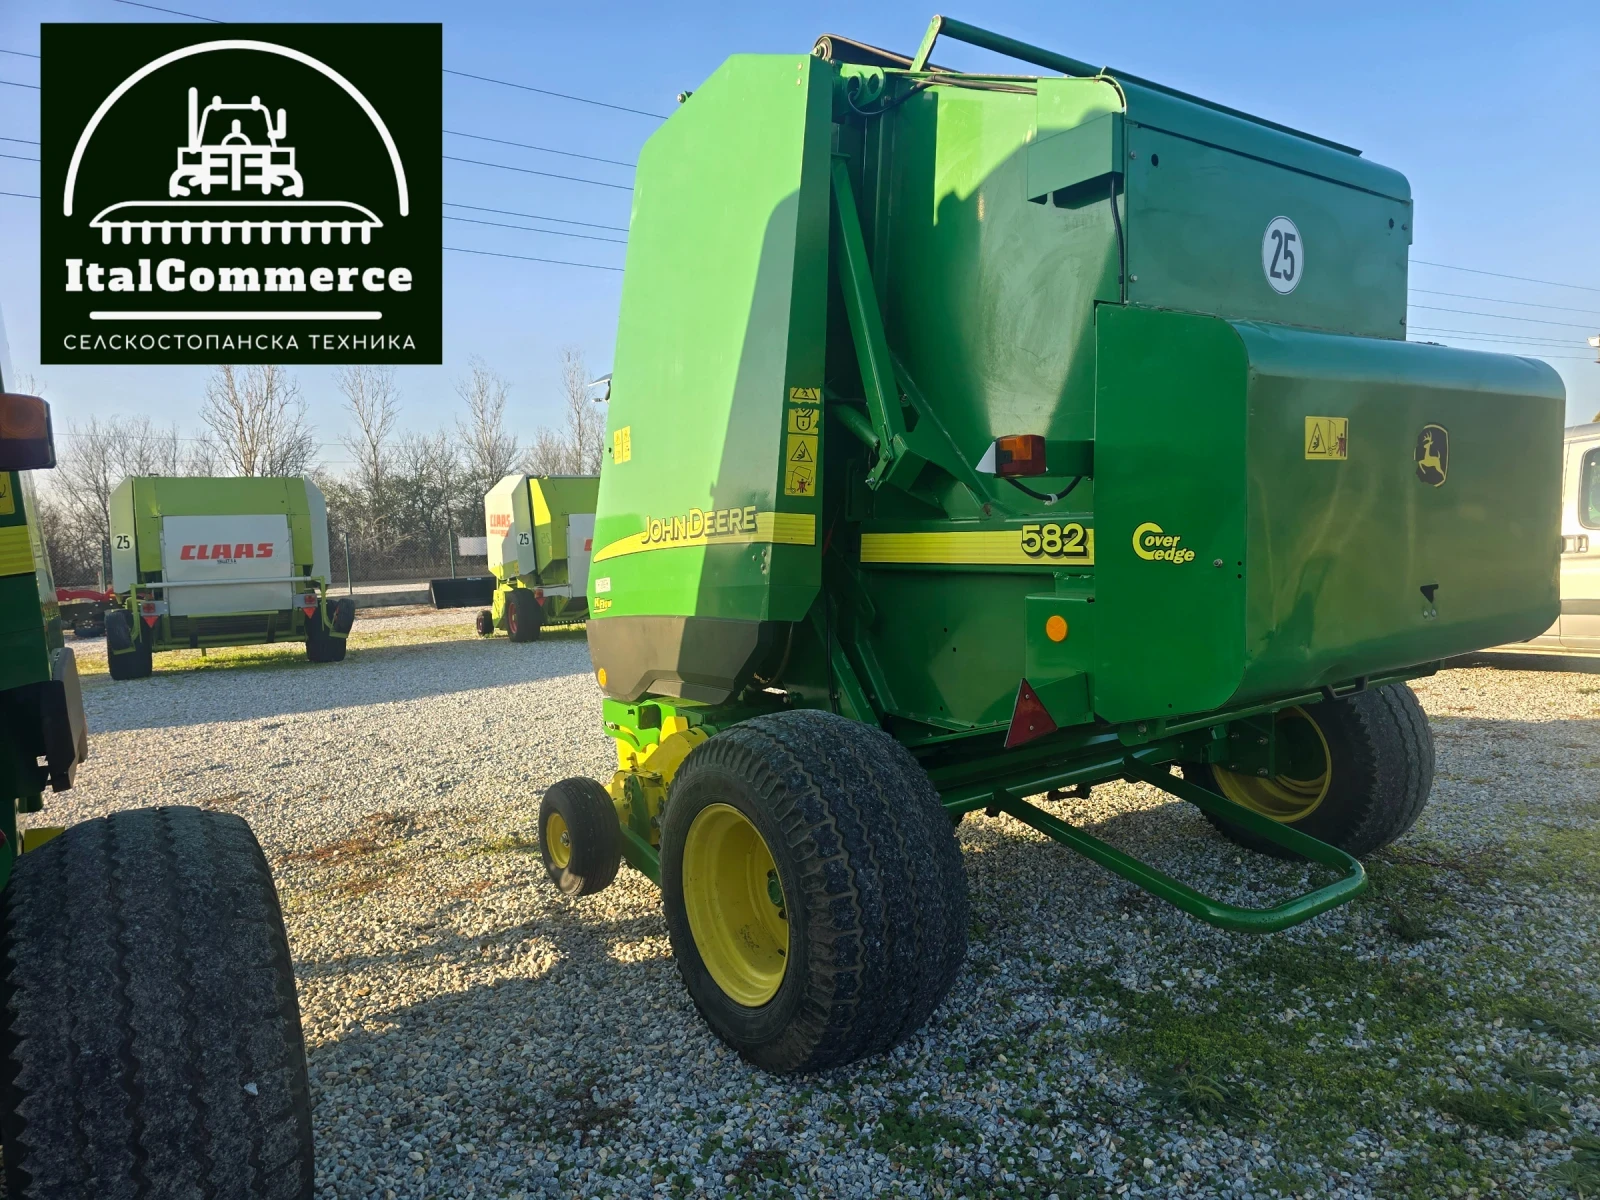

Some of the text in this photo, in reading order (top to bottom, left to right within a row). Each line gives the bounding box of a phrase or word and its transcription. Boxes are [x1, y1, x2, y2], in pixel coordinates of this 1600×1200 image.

[1269, 228, 1297, 282] 25
[489, 513, 511, 527] CLAAS
[640, 505, 758, 545] JOHN DEERE
[116, 535, 130, 549] 25
[519, 533, 530, 545] 25
[1021, 522, 1087, 556] 582
[180, 543, 274, 560] CLAAS
